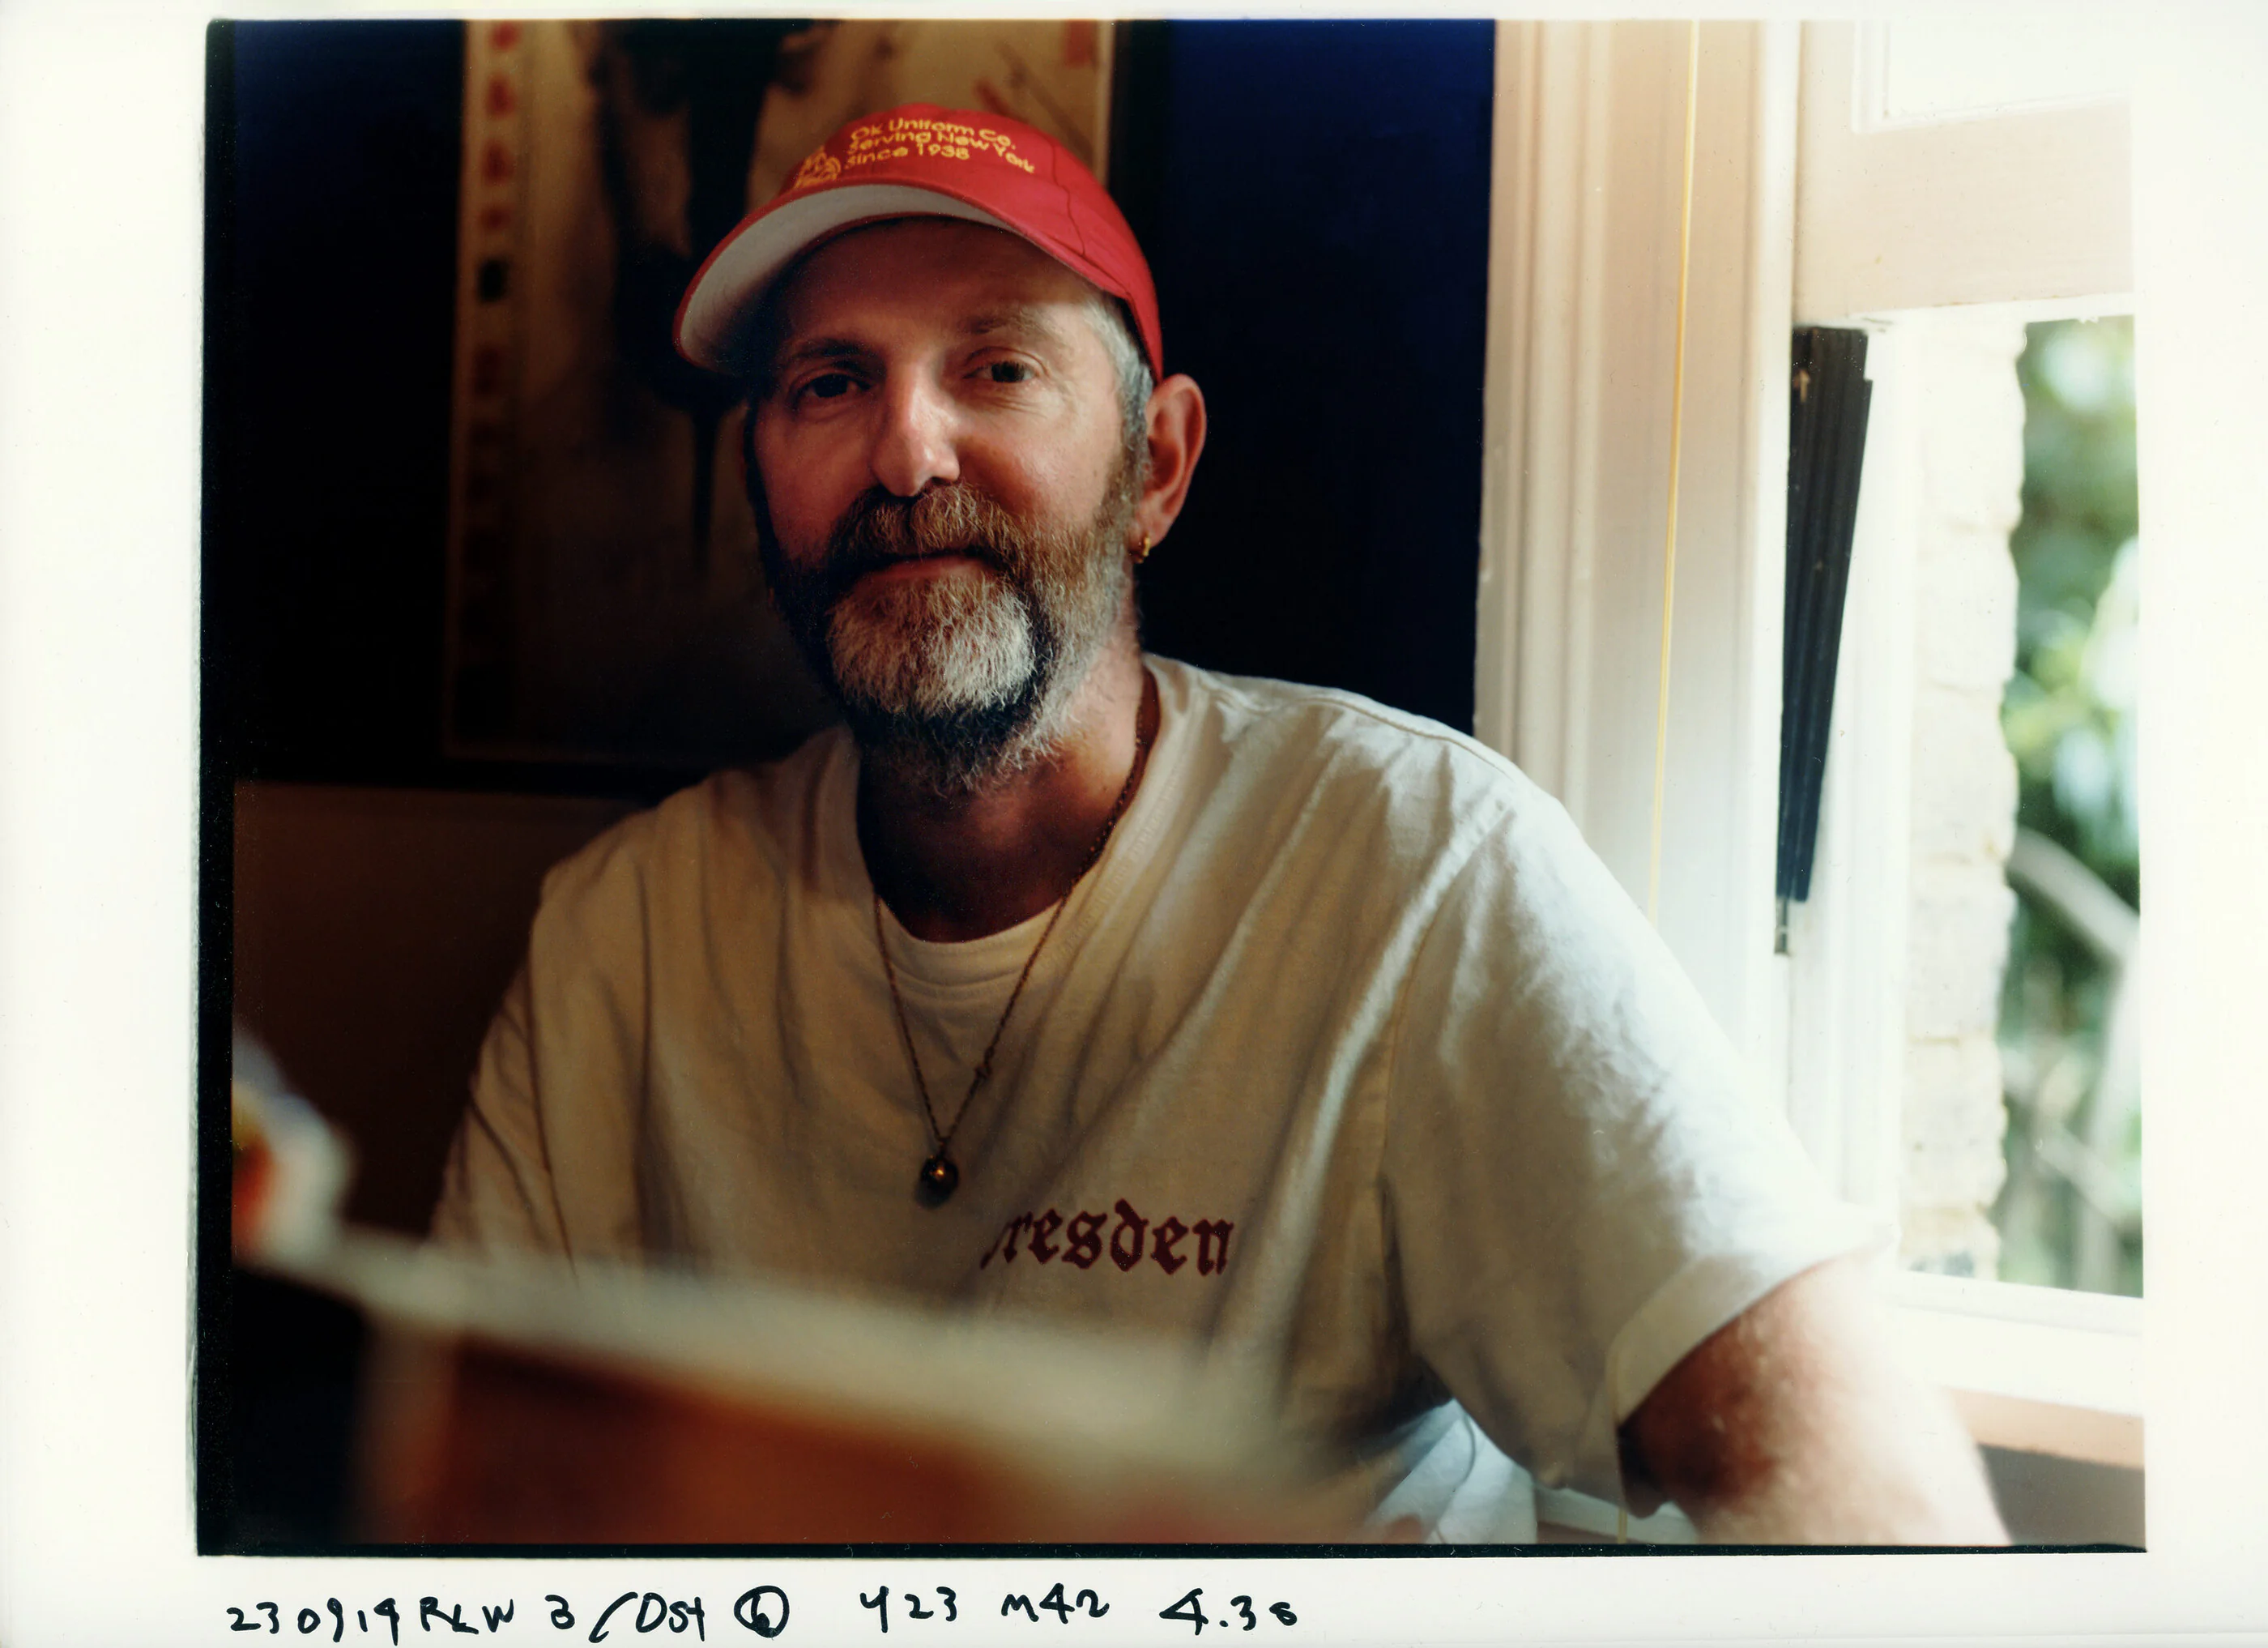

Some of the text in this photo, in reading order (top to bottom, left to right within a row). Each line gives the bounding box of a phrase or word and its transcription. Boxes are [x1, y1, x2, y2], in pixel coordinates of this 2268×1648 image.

[888, 117, 975, 136] Uniform
[937, 131, 991, 151] New
[980, 1198, 1234, 1276] resden
